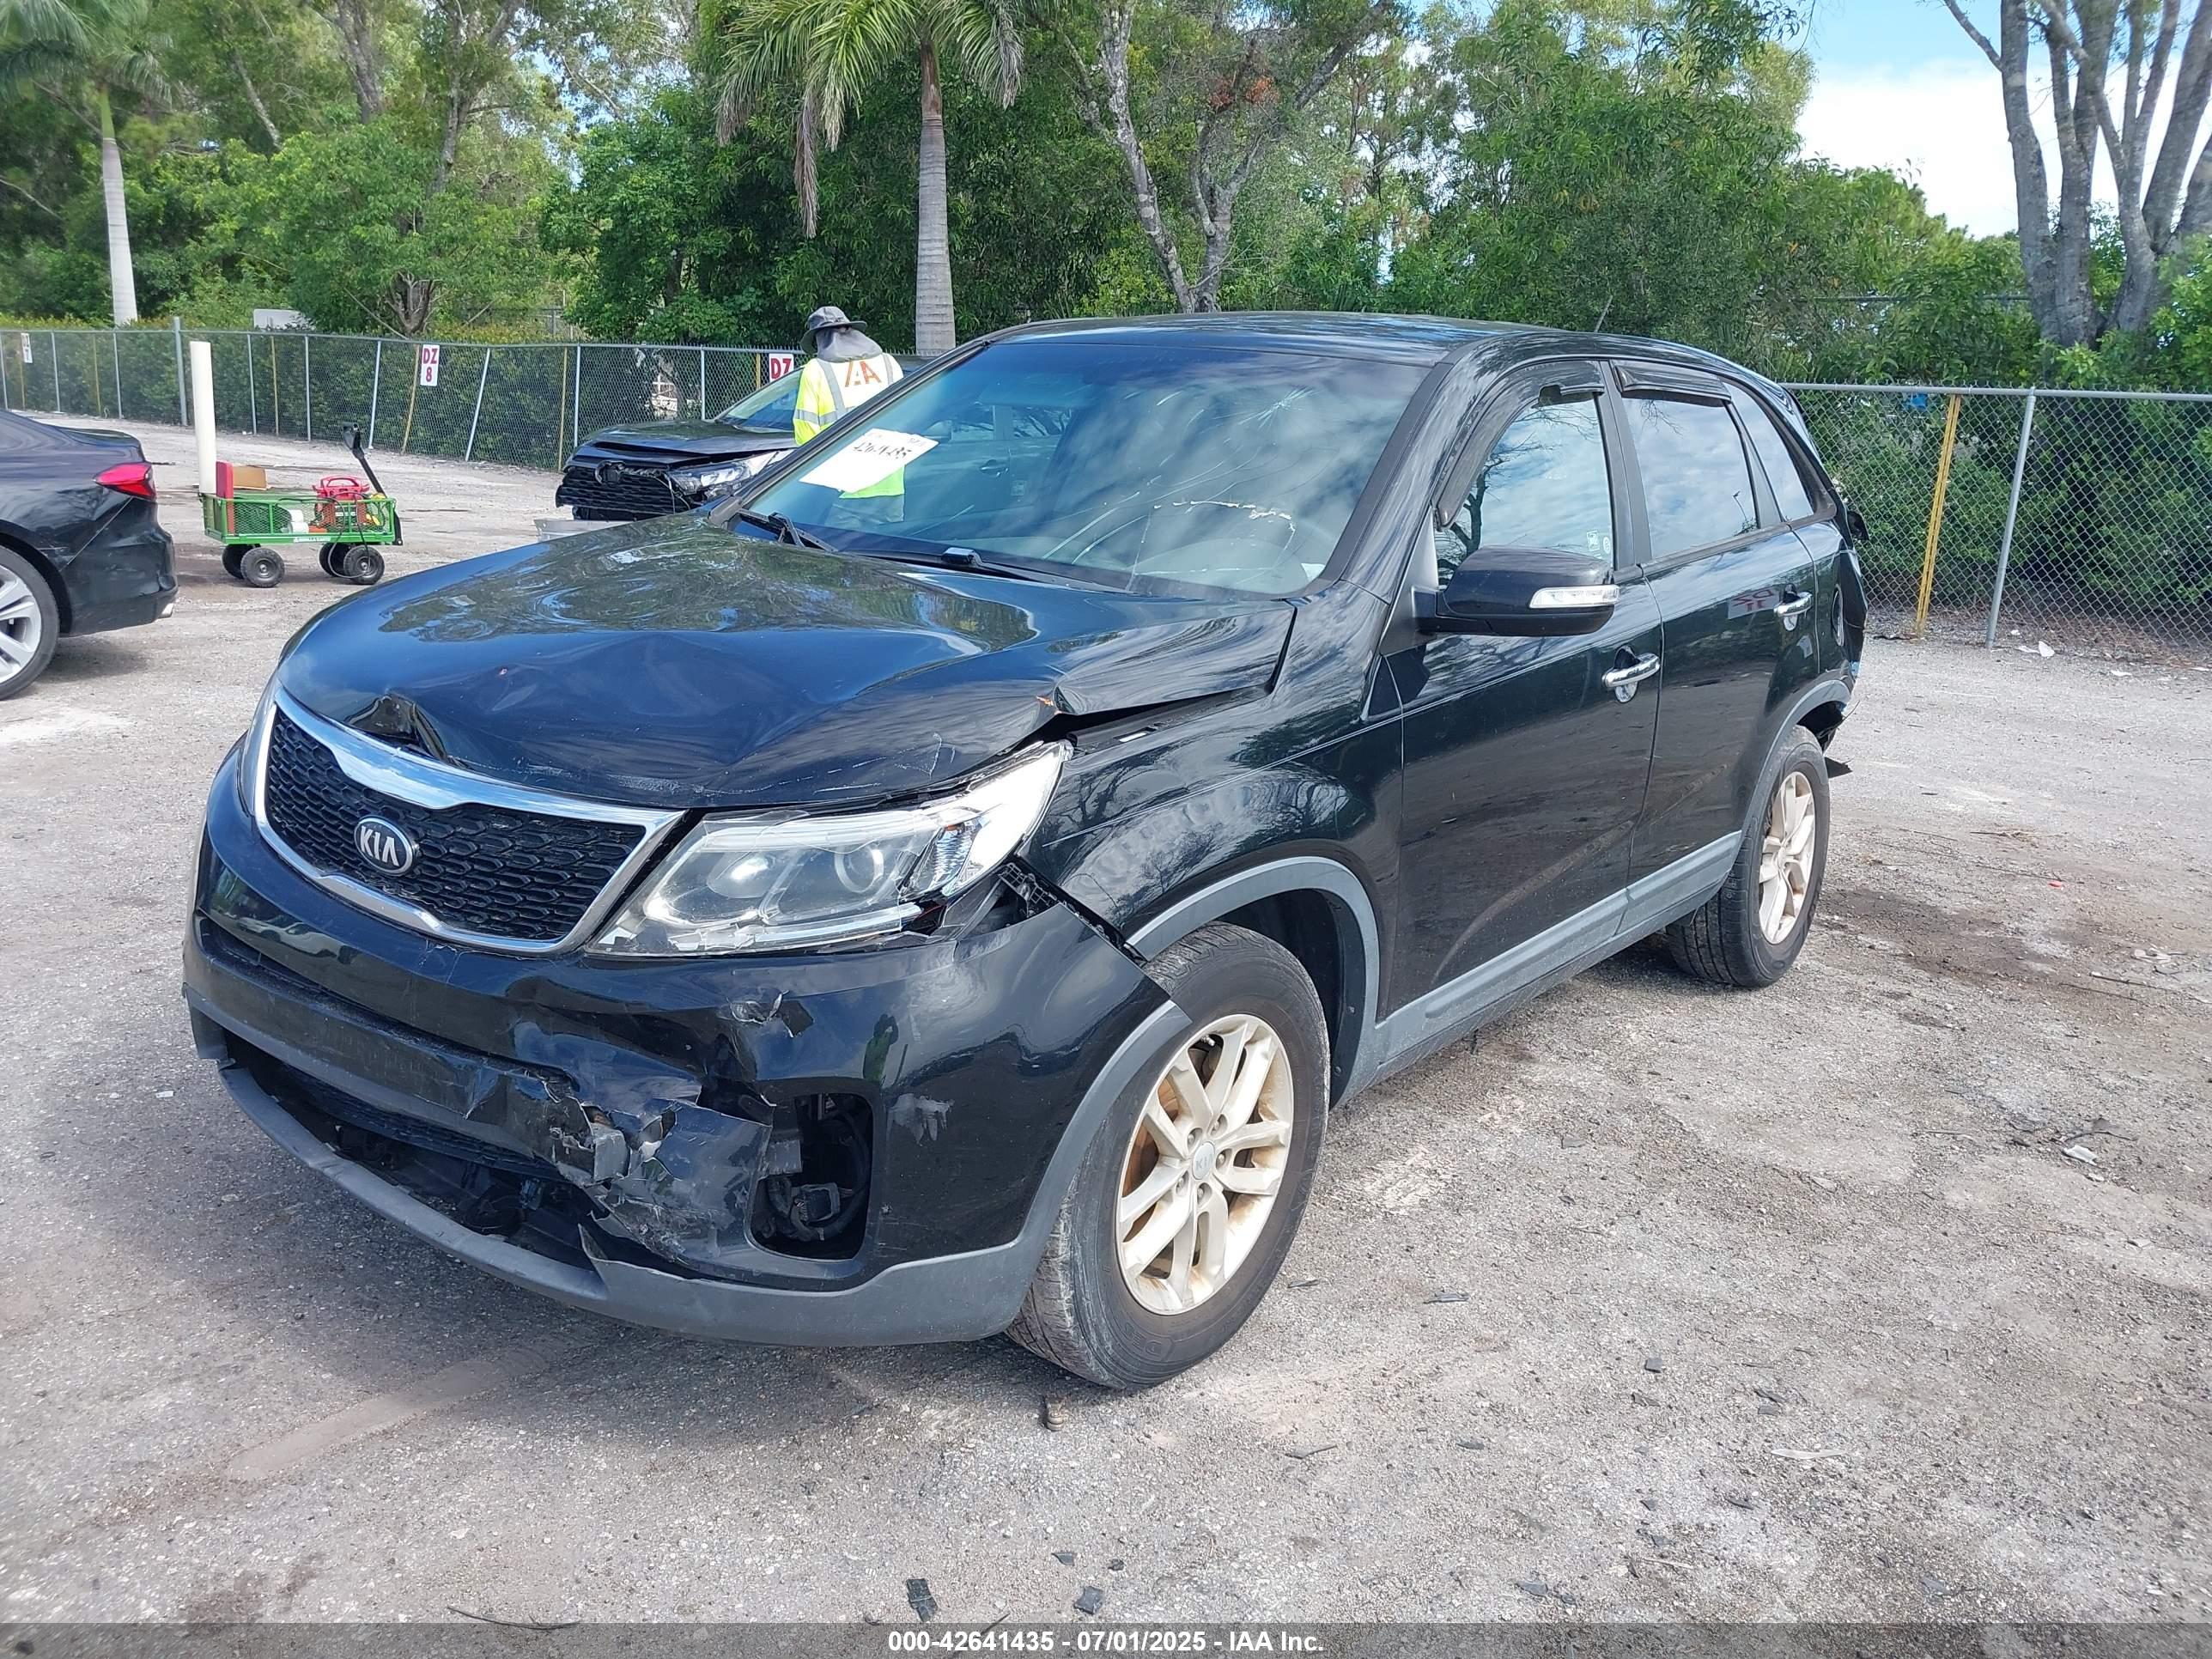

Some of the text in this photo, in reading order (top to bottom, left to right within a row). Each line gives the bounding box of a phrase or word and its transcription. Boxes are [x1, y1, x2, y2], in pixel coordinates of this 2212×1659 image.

[423, 348, 438, 364] DZ
[426, 367, 432, 382] 8
[361, 825, 399, 866] KIA
